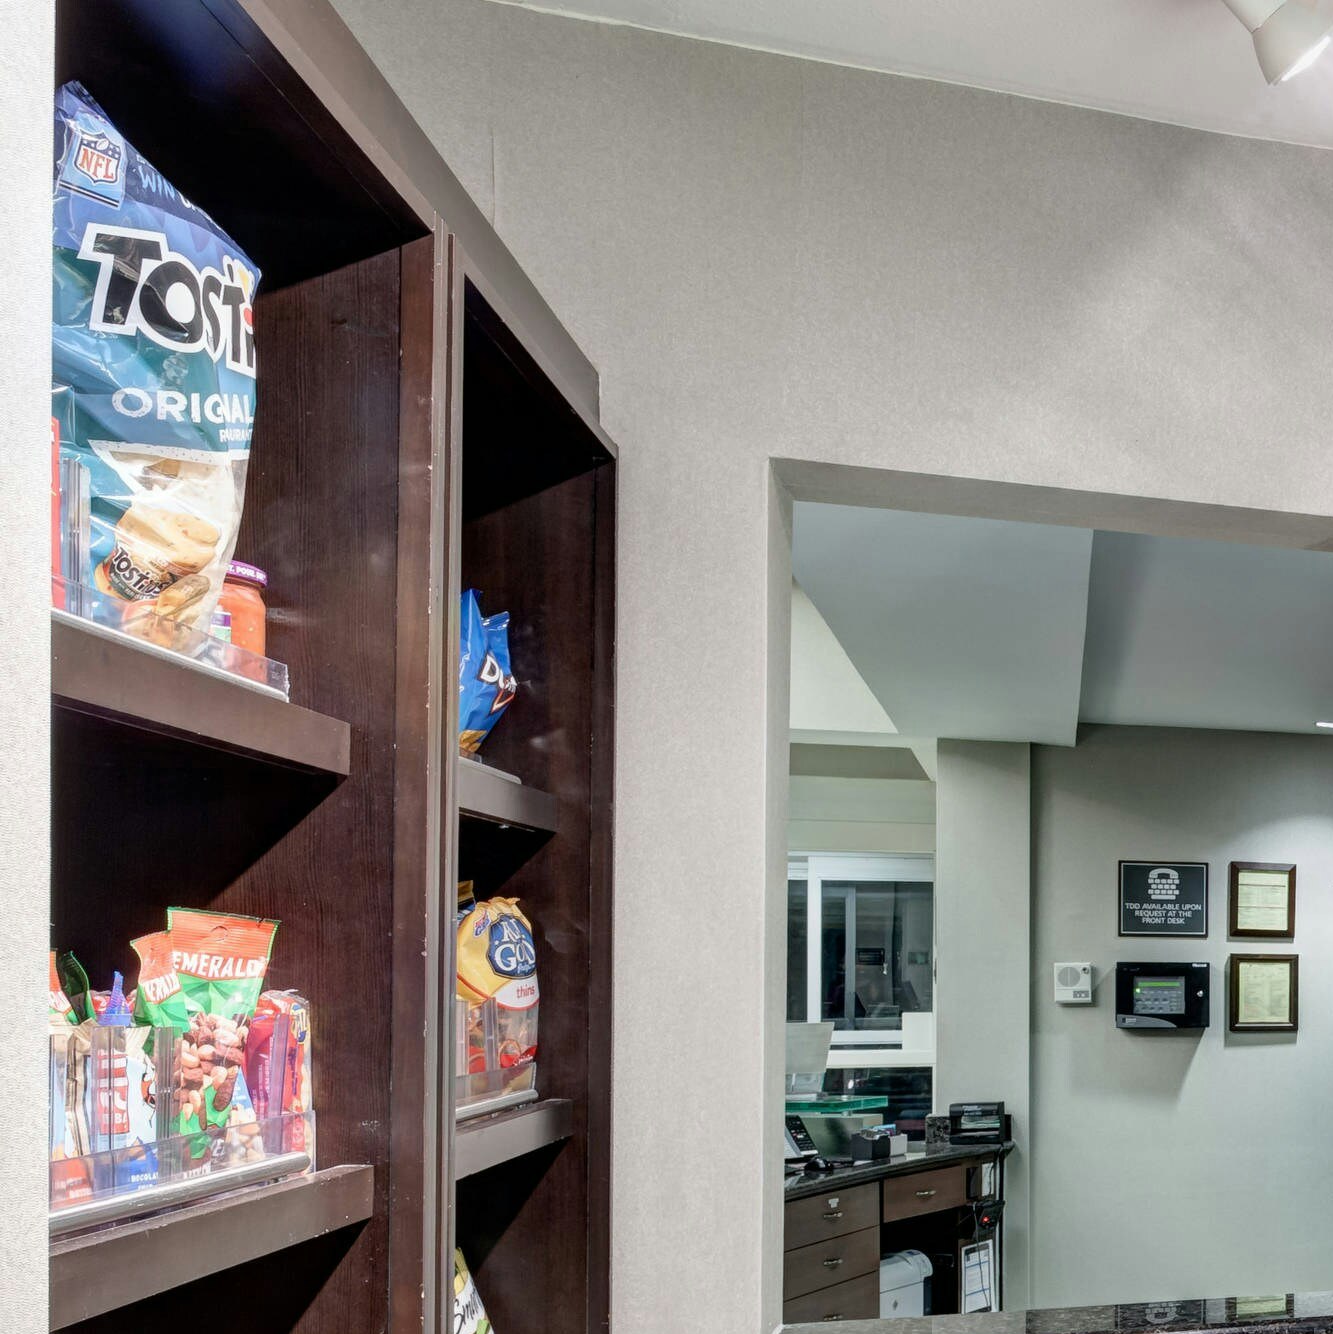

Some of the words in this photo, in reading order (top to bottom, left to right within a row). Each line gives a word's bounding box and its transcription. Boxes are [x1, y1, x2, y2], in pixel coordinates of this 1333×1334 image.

[79, 149, 114, 179] NFL
[138, 165, 176, 198] WIN
[172, 951, 265, 979] EMERALD
